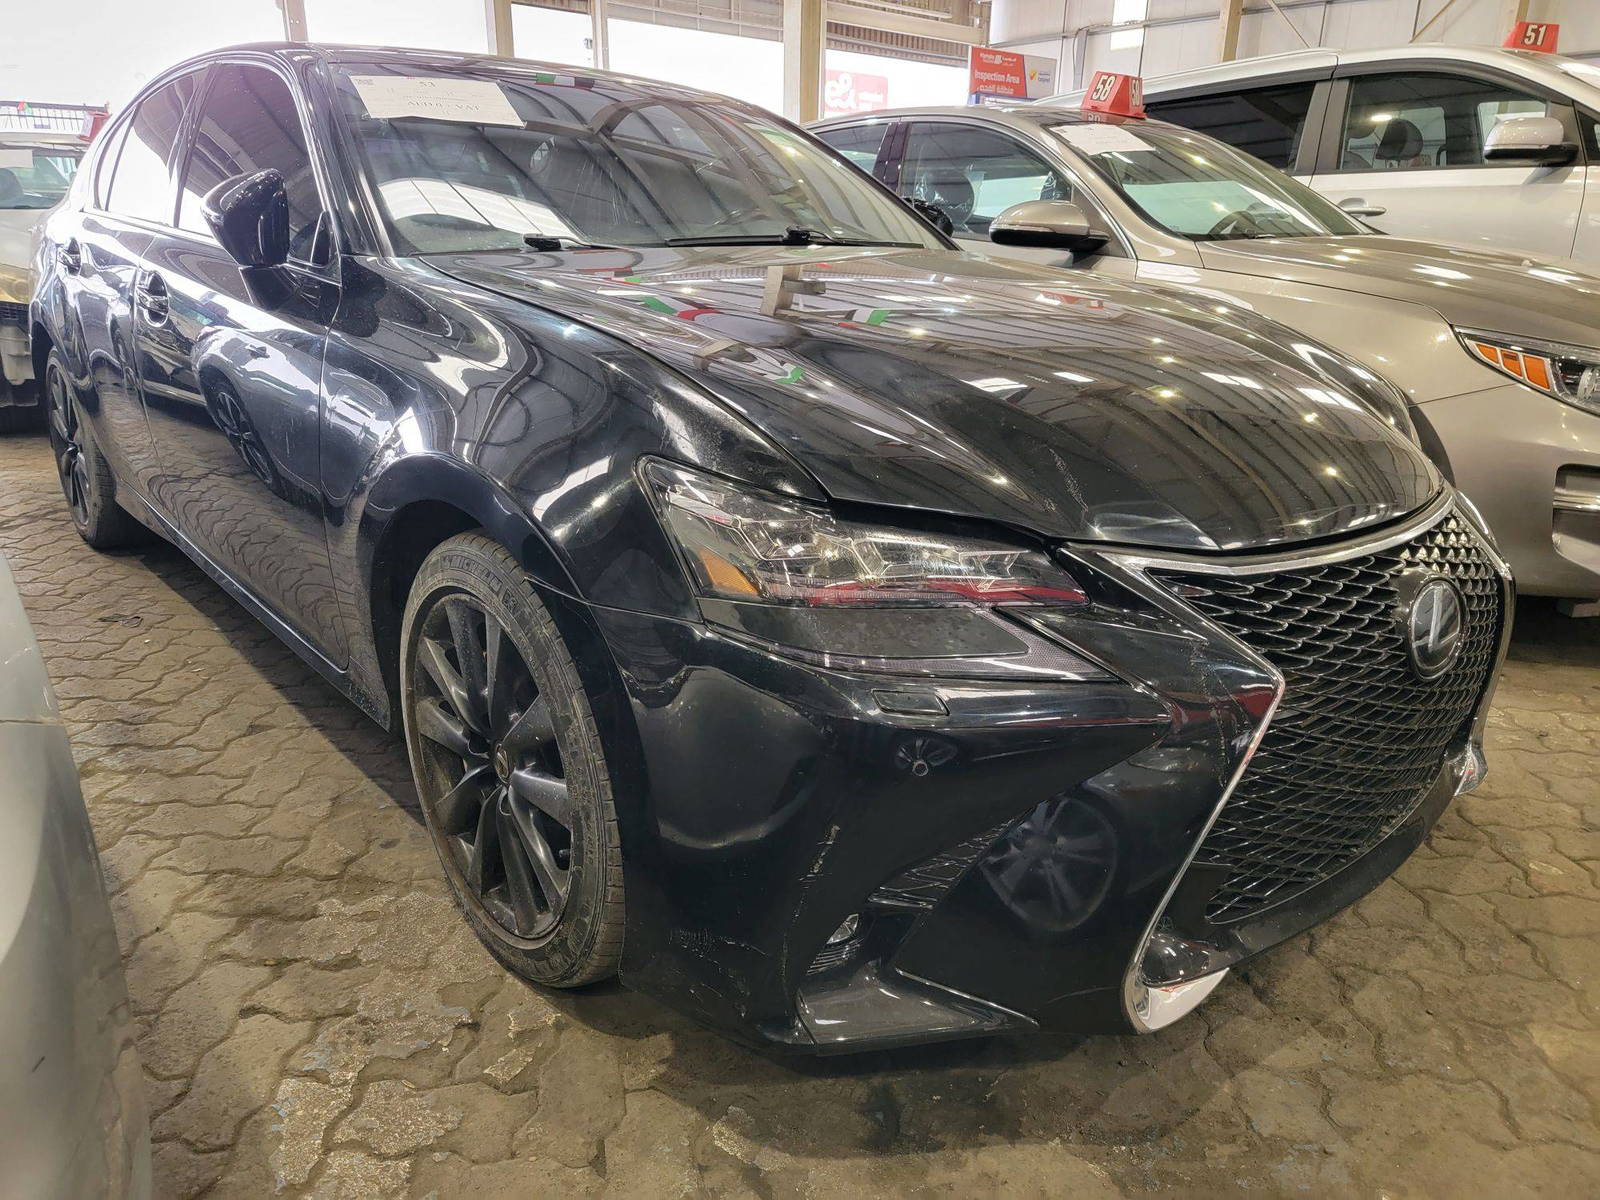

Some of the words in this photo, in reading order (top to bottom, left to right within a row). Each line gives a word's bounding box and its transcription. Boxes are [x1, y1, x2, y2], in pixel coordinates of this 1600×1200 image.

[1524, 24, 1547, 46] 51
[975, 69, 1006, 83] Inspection
[1006, 73, 1020, 84] Area
[1091, 75, 1116, 101] 58
